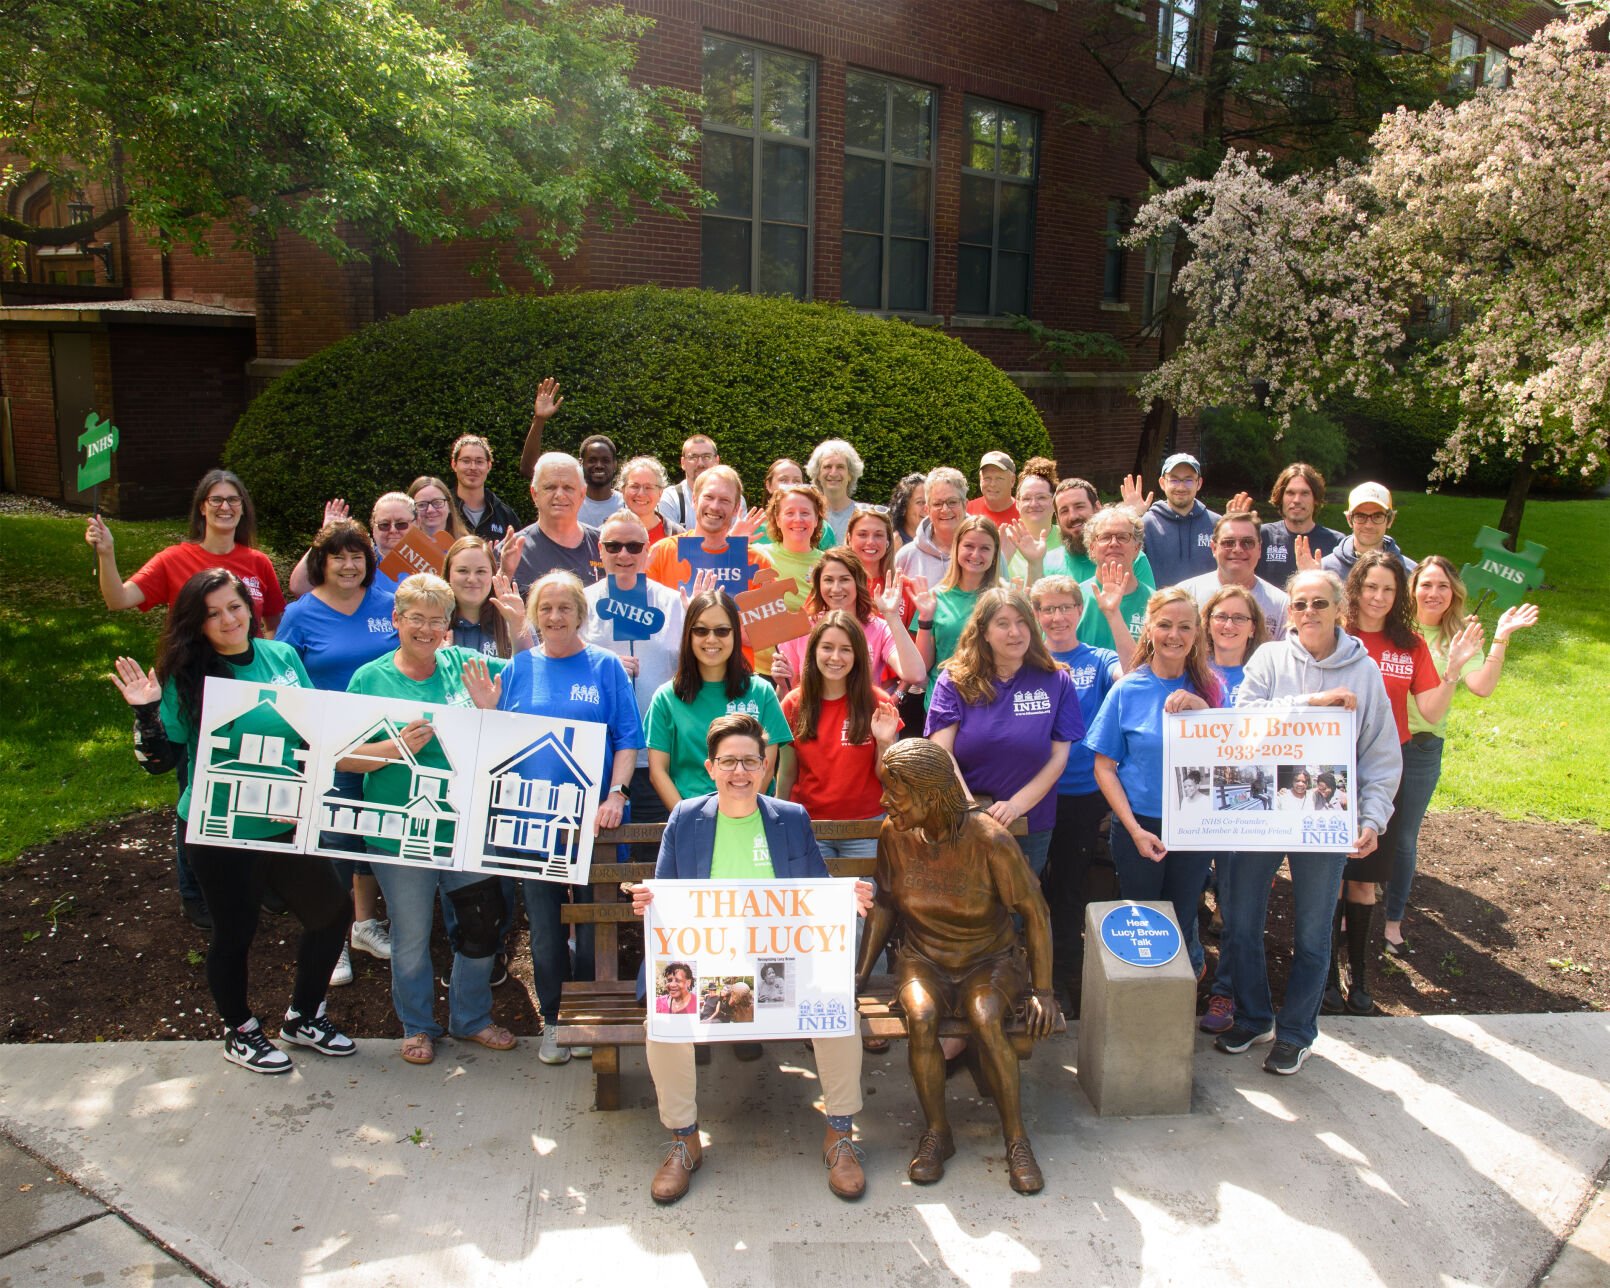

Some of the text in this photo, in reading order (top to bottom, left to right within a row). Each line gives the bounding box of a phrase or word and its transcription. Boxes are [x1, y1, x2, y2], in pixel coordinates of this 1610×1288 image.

[88, 433, 113, 458] INHS
[1482, 559, 1525, 584] INHS
[606, 599, 654, 626] INHS
[740, 598, 787, 625] INHS
[1380, 661, 1413, 675] INHS
[570, 693, 600, 705] INHS
[1014, 701, 1051, 712] INHS
[1179, 717, 1342, 743] Lucy J. Brown
[1217, 744, 1304, 760] 1933-2025
[1201, 827, 1231, 835] Member
[1302, 832, 1349, 844] INHS
[689, 889, 815, 918] THANK
[1126, 919, 1149, 927] Hear
[1111, 929, 1135, 938] Lucy
[653, 924, 846, 961] YOU, LUCY!
[1130, 938, 1152, 946] Talk
[798, 1015, 847, 1030] INHS
